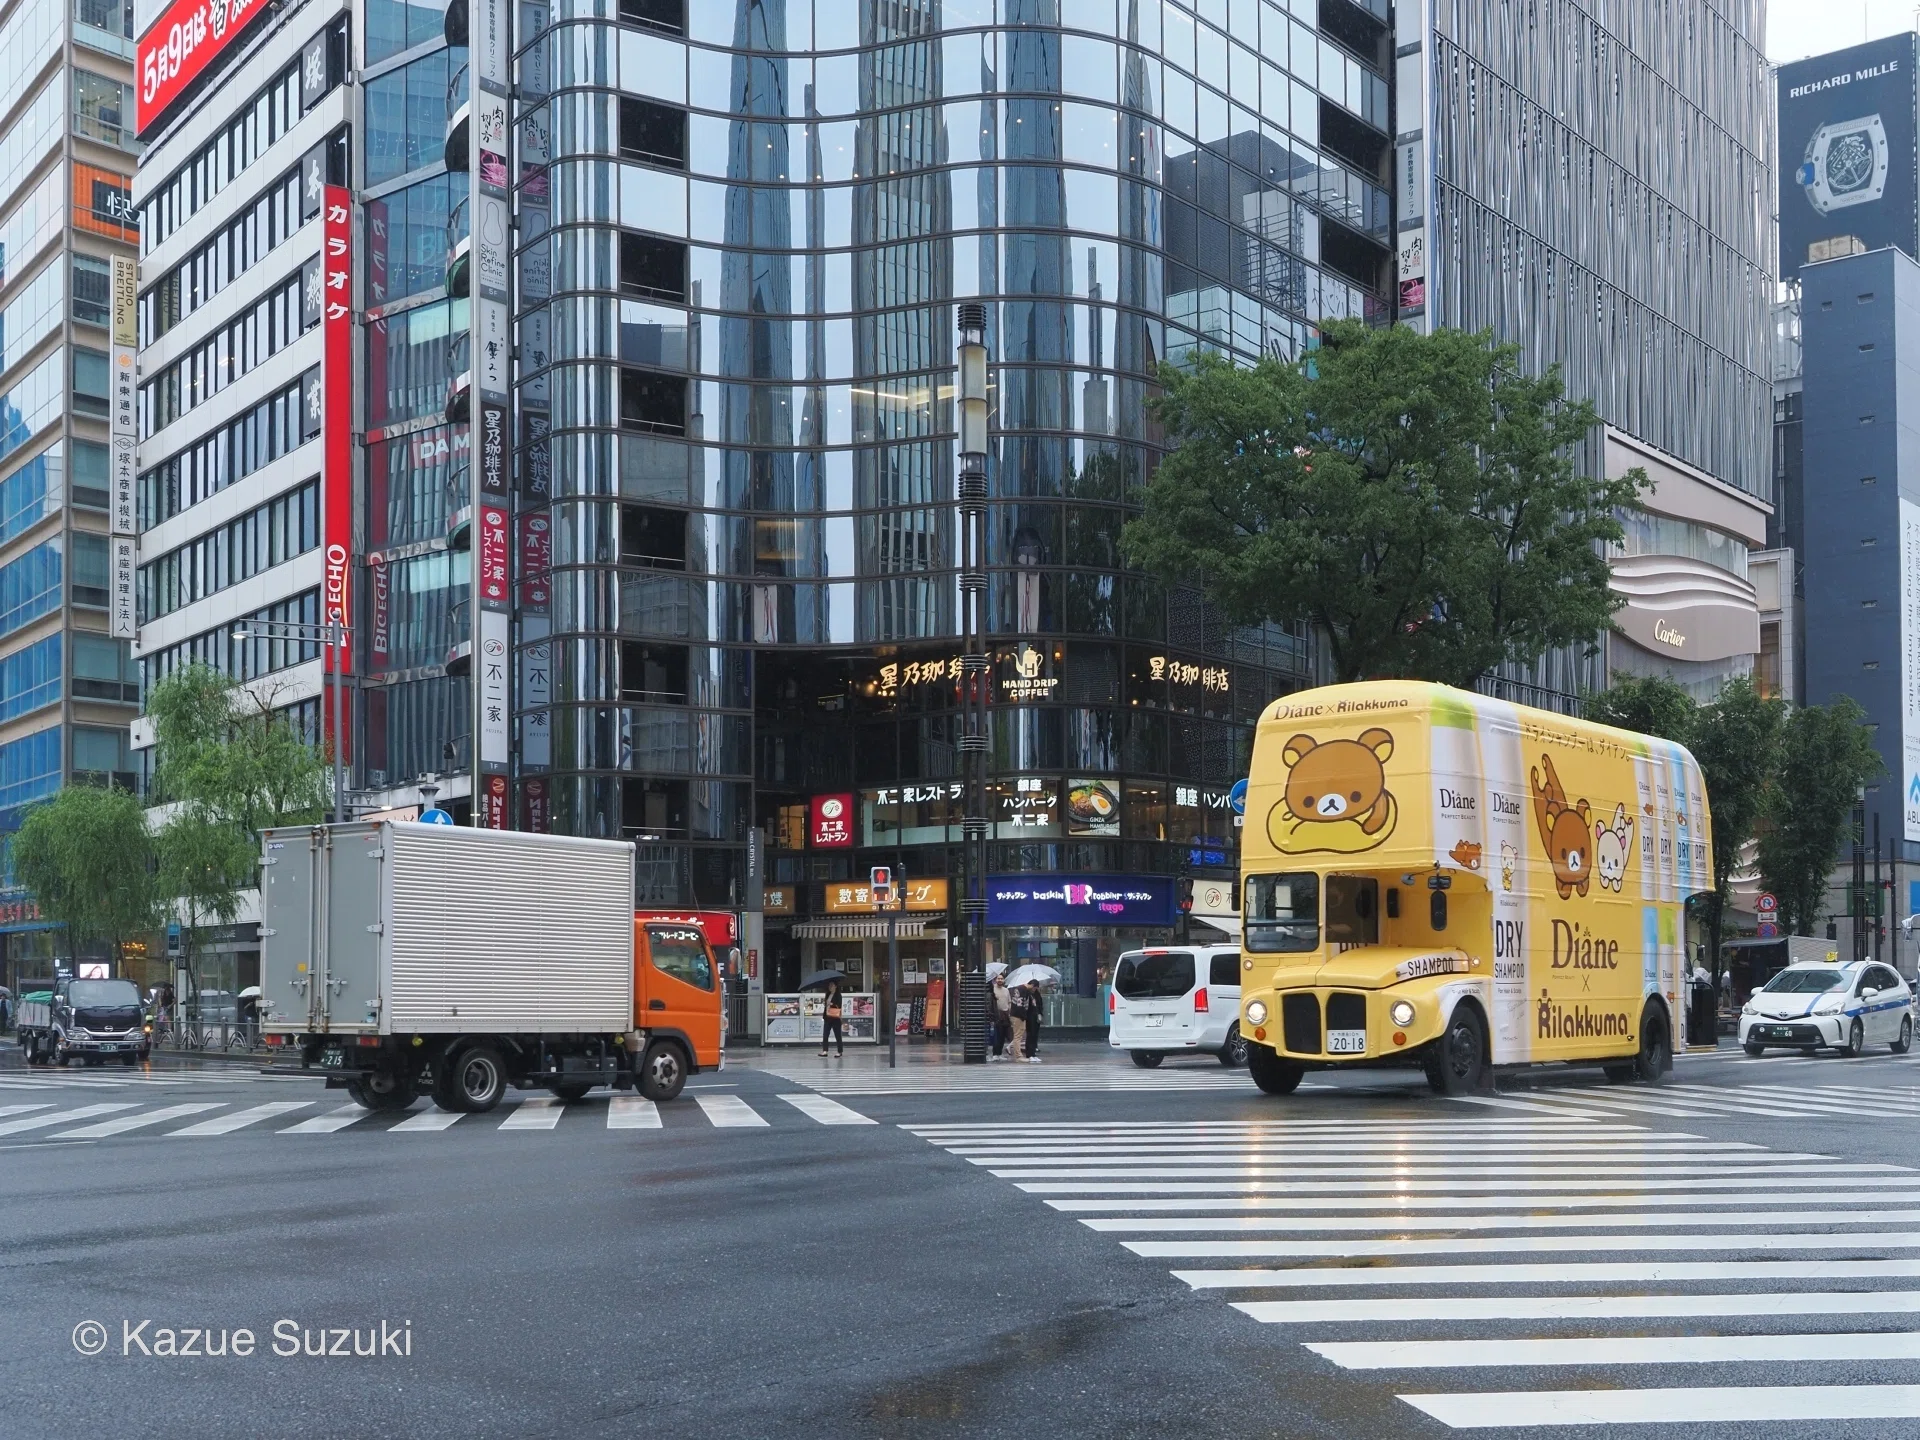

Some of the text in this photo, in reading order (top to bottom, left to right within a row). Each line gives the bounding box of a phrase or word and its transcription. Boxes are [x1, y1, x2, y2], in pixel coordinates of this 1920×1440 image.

[1790, 61, 1898, 98] RICHARD MILLE
[107, 191, 141, 222] 快
[480, 244, 498, 258] Skin
[326, 204, 349, 320] カラオケ
[480, 252, 506, 269] Refine
[480, 262, 503, 277] Clinic
[116, 261, 125, 325] BREITLING
[125, 262, 134, 307] STUDIO
[488, 288, 498, 296] 5F
[119, 371, 130, 426] 新東通信
[484, 410, 501, 488] 星乃珈琲店
[119, 452, 131, 531] 塚本商事機械
[483, 526, 492, 578] レストラン
[493, 528, 504, 581] 不二家
[326, 544, 346, 603] ECHO
[118, 544, 131, 633] 銀座税理士法人
[1654, 618, 1686, 648] Cartier
[1149, 656, 1230, 694] 星乃珈琲店
[486, 663, 502, 722] 不二家
[1002, 679, 1058, 689] HAND DRIP
[1011, 688, 1049, 697] COFFEE
[1337, 700, 1408, 713] Rilakkuma
[489, 762, 498, 770] 1F
[1017, 779, 1042, 792] 銀座
[1003, 795, 1058, 808] ハンバーグ
[821, 820, 843, 831] 不二家
[1012, 813, 1049, 827] 不二家
[816, 832, 848, 843] レストラン
[1643, 836, 1653, 853] DRY
[1661, 838, 1671, 855] DRY
[1678, 842, 1689, 859] DRY
[1695, 845, 1705, 860] DRY
[1033, 891, 1064, 900] baskin
[1496, 919, 1524, 958] DRY
[1407, 957, 1454, 977] SHAMPOO
[1494, 963, 1525, 979] SHAMPOO
[1537, 998, 1628, 1039] Rilakkuma
[1333, 1037, 1364, 1051] 20-18
